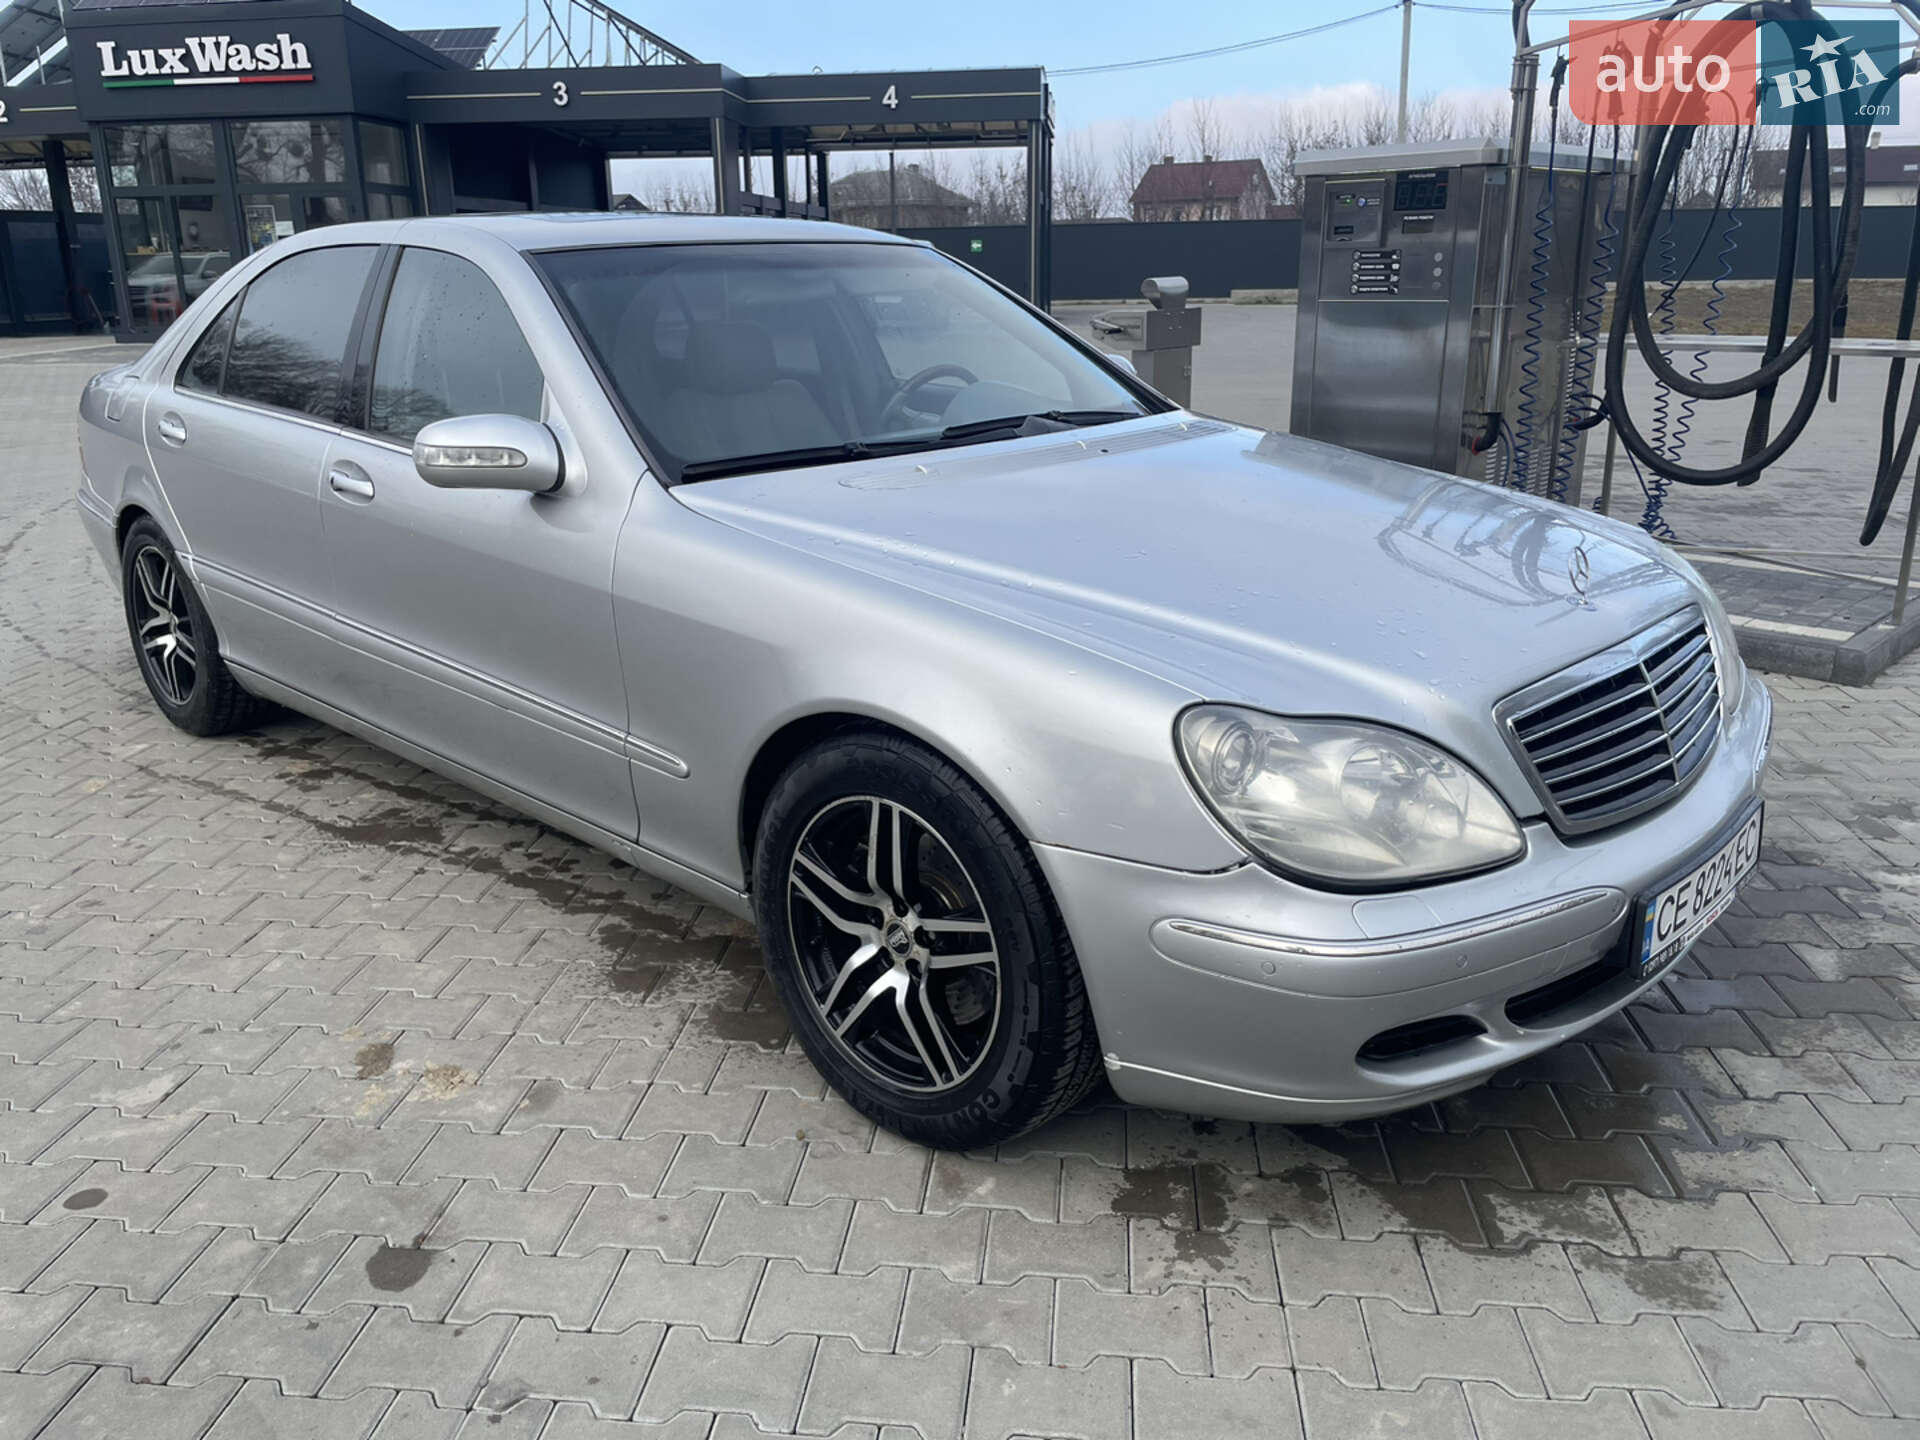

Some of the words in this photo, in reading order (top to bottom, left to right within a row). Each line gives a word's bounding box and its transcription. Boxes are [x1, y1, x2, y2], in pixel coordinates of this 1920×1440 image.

[553, 81, 568, 106] 3
[882, 85, 899, 109] 4
[1656, 880, 1692, 942] CE
[1692, 842, 1736, 916] 8224
[1735, 819, 1757, 877] EC
